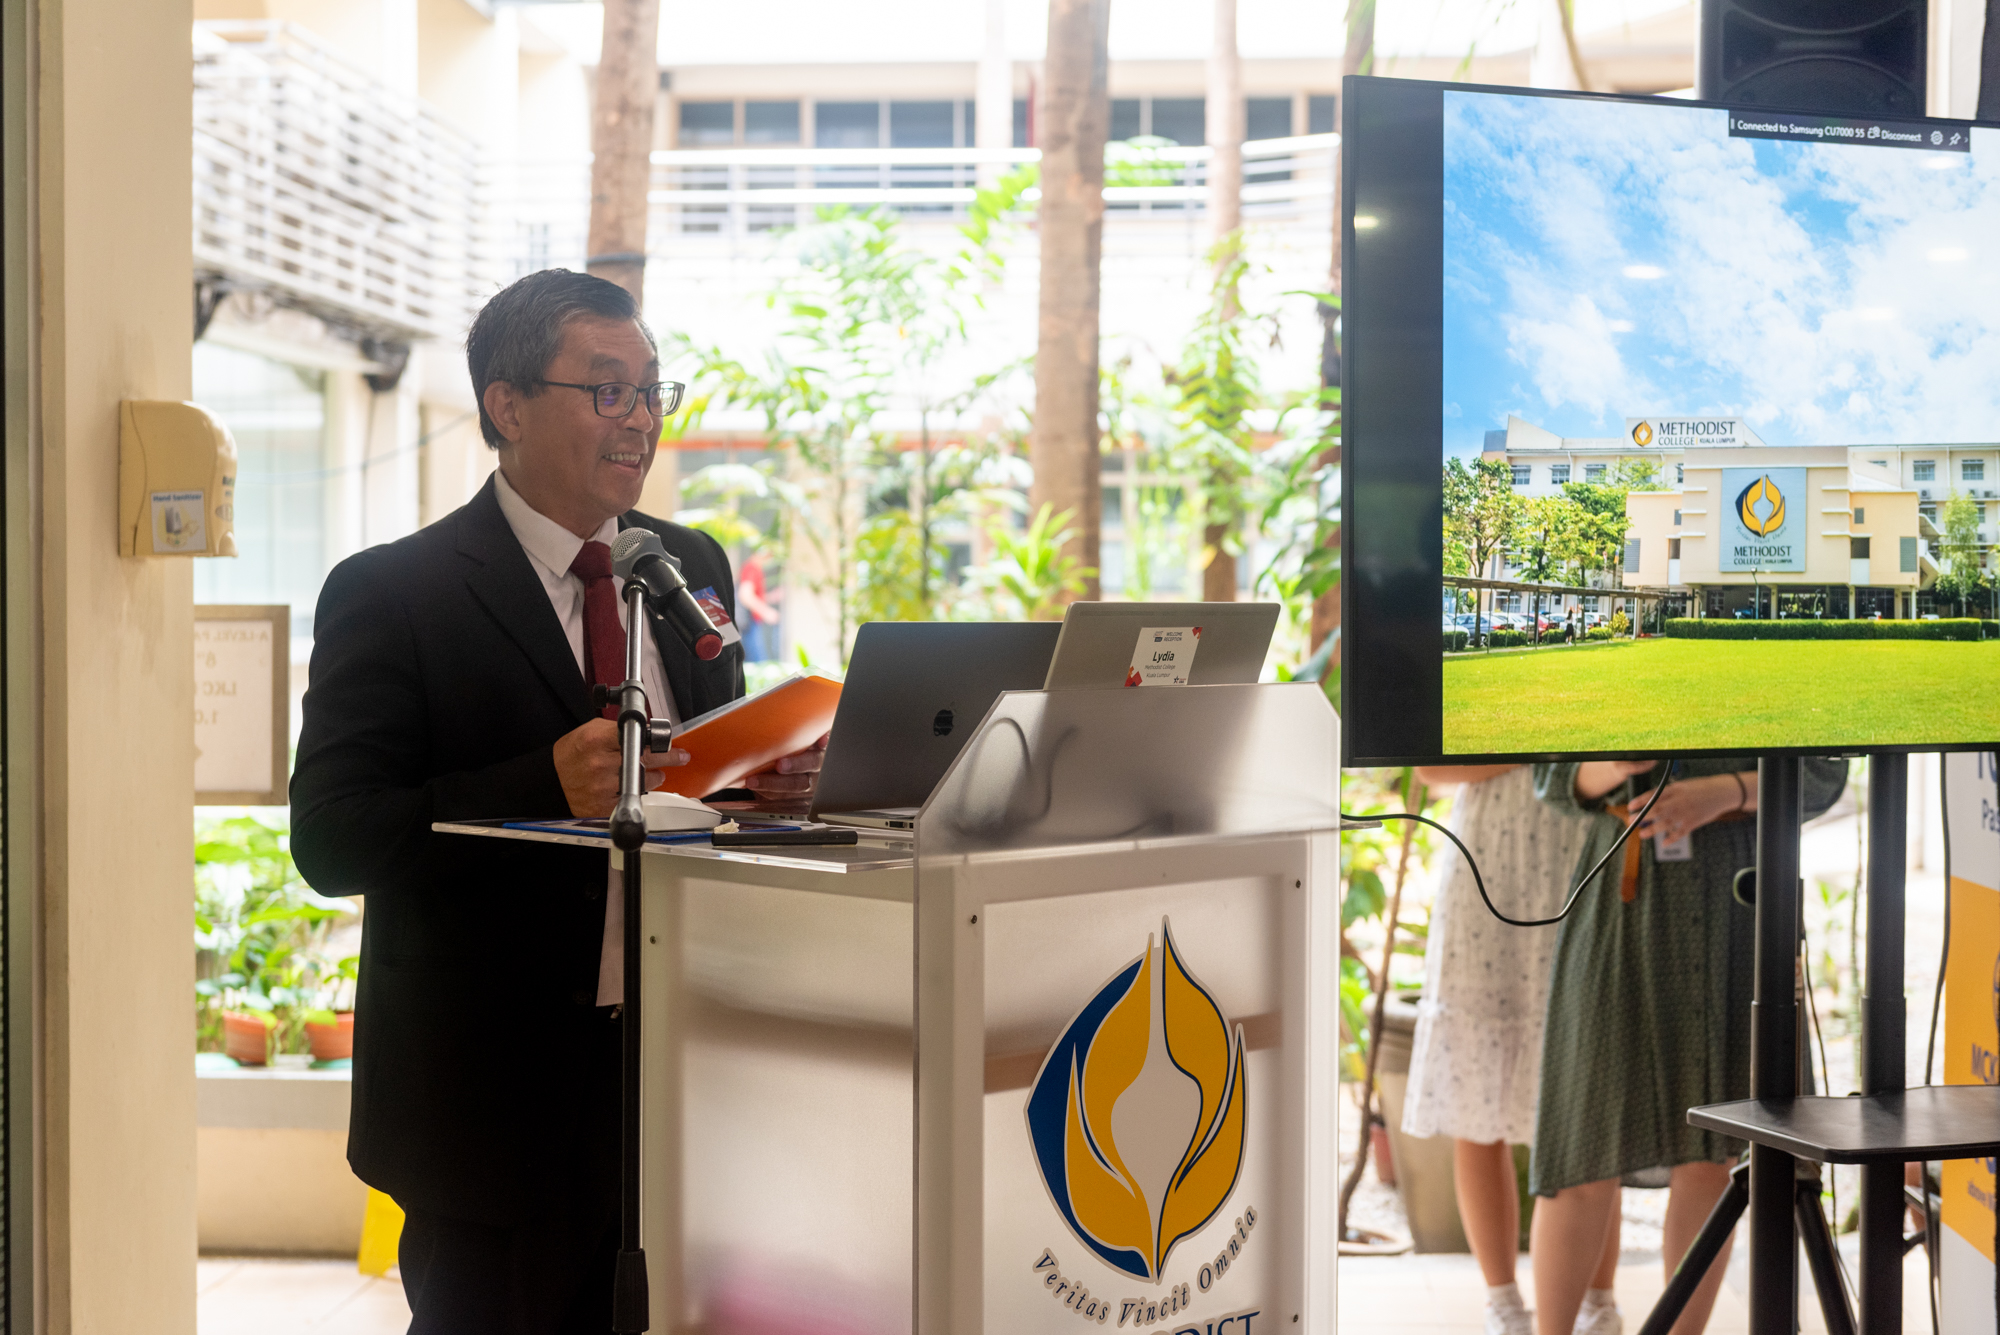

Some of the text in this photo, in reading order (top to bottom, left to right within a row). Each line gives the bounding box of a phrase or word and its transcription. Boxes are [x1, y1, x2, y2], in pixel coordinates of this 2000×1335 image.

[1737, 120, 1778, 133] Connected
[1779, 124, 1788, 133] to
[1789, 123, 1823, 138] Samsung
[1824, 126, 1854, 138] CU7000
[1881, 130, 1922, 142] Disconnect
[1659, 421, 1735, 435] METHODIST
[1658, 436, 1695, 446] COLLEGE
[1734, 546, 1791, 557] METHODIST
[1733, 557, 1761, 566] COLLEGE
[1152, 651, 1175, 663] Lydia
[1035, 1209, 1255, 1324] Veritas Vincit Omnia
